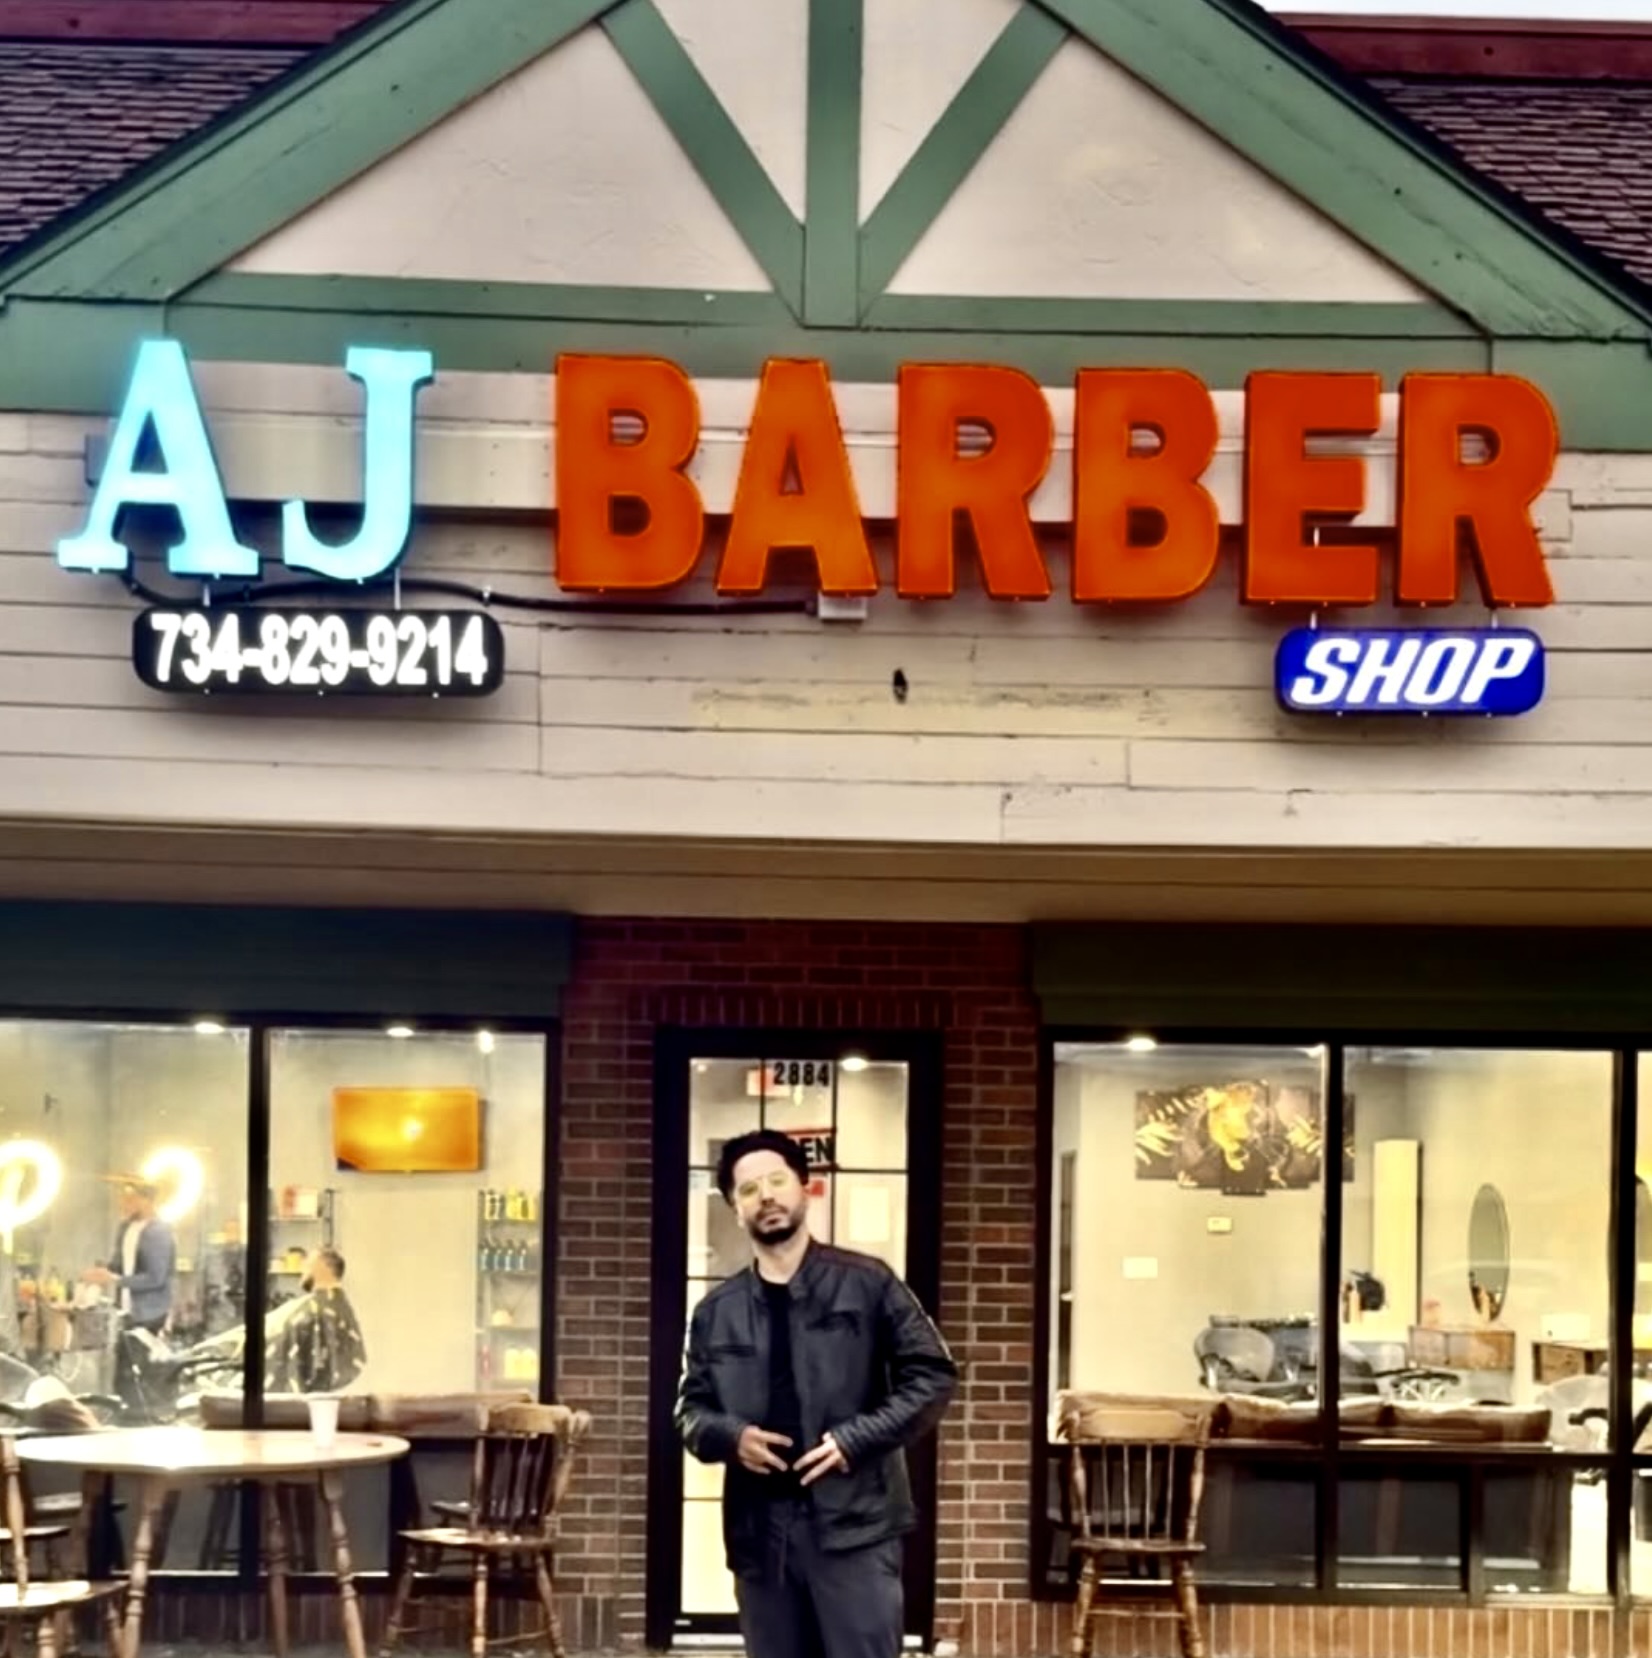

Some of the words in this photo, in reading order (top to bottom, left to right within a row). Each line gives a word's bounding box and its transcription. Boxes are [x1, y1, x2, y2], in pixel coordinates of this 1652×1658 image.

[57, 339, 434, 581] AJ
[554, 352, 1561, 607] BARBER
[150, 612, 489, 686] 734-829-9214
[1290, 636, 1534, 706] SHOP
[773, 1062, 830, 1086] 2884
